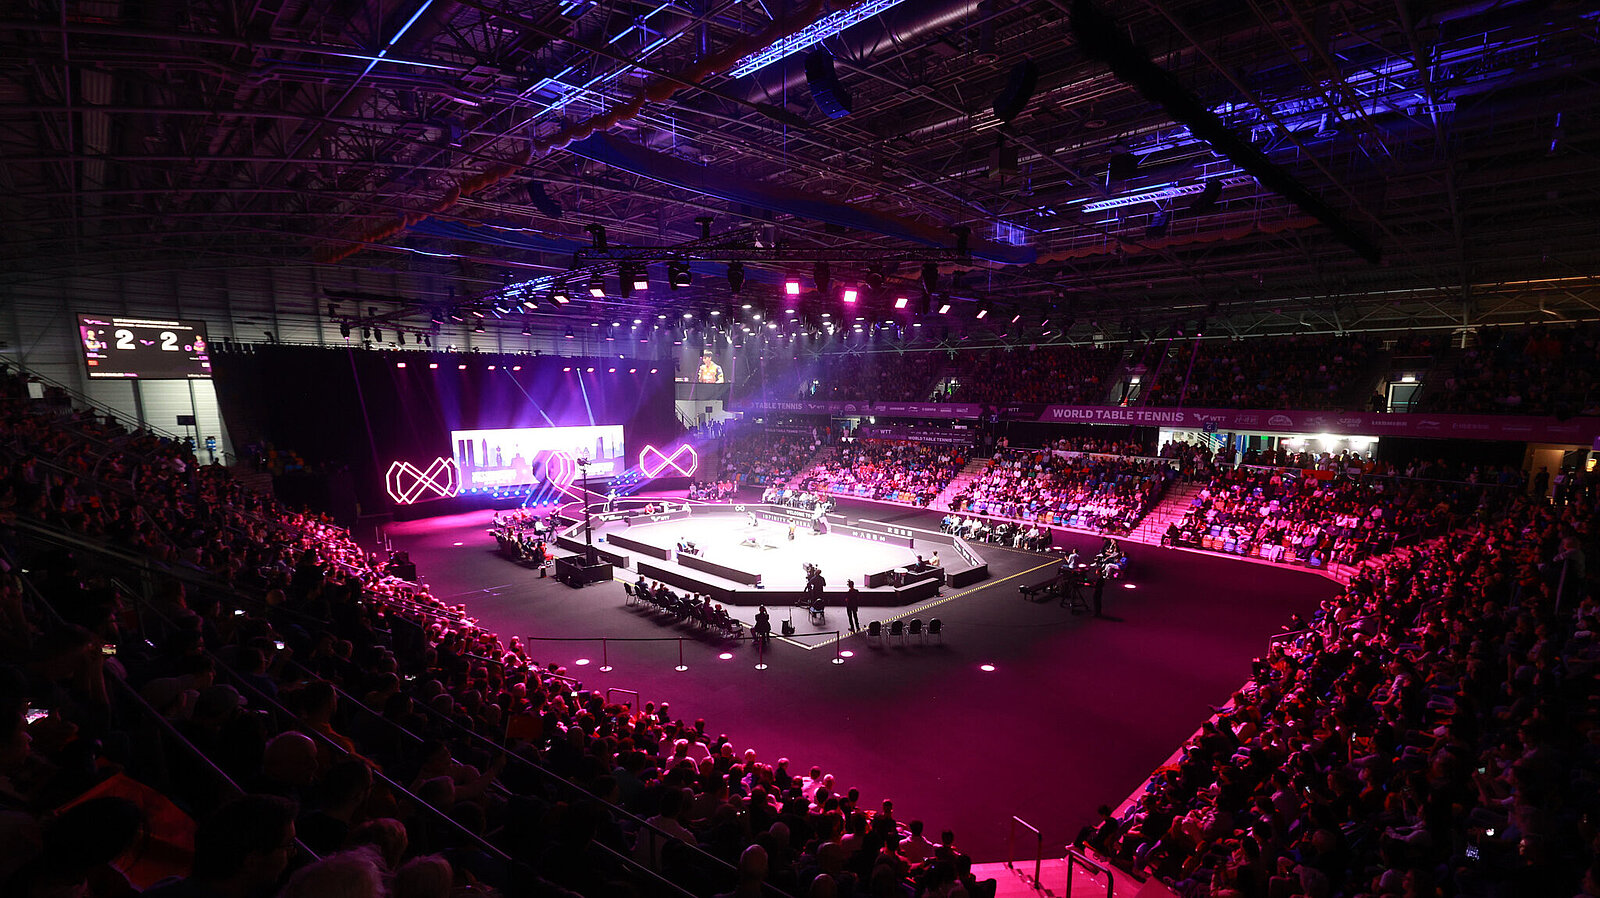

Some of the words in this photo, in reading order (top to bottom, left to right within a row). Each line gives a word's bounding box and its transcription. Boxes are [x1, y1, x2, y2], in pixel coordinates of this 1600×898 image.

[115, 329, 136, 350] 2
[160, 331, 179, 351] 2
[1053, 409, 1093, 419] WORLD
[1096, 410, 1134, 420] TABLE
[1137, 411, 1184, 422] TENNIS
